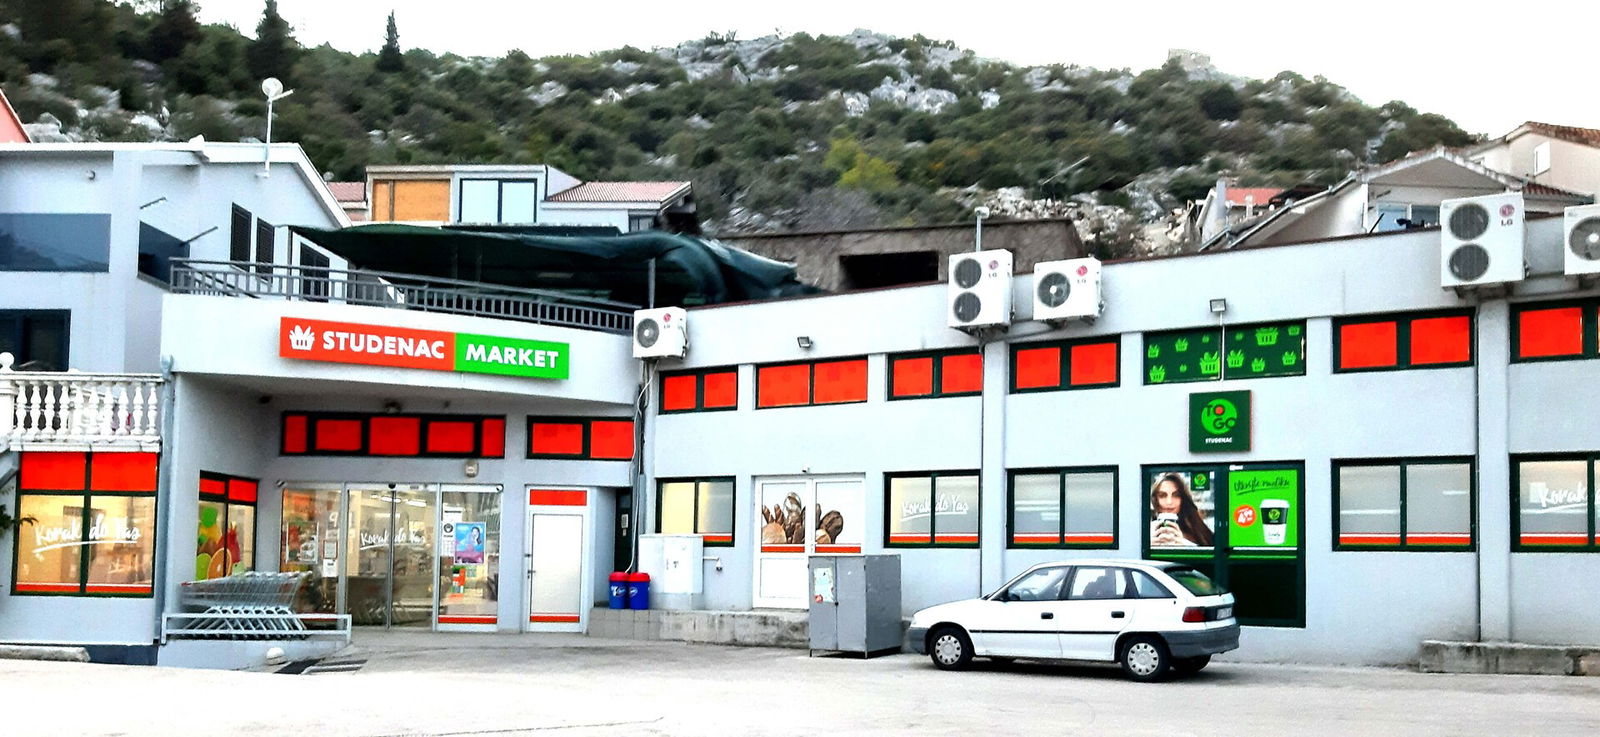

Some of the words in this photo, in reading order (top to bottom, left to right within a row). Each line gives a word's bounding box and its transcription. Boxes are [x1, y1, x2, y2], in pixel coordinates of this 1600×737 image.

[323, 331, 445, 359] STUDENAC
[465, 344, 559, 369] MARKET
[1203, 402, 1225, 416] TO
[1212, 417, 1238, 430] GO
[1540, 481, 1587, 508] Korak
[34, 518, 81, 546] Korak
[89, 513, 107, 540] do
